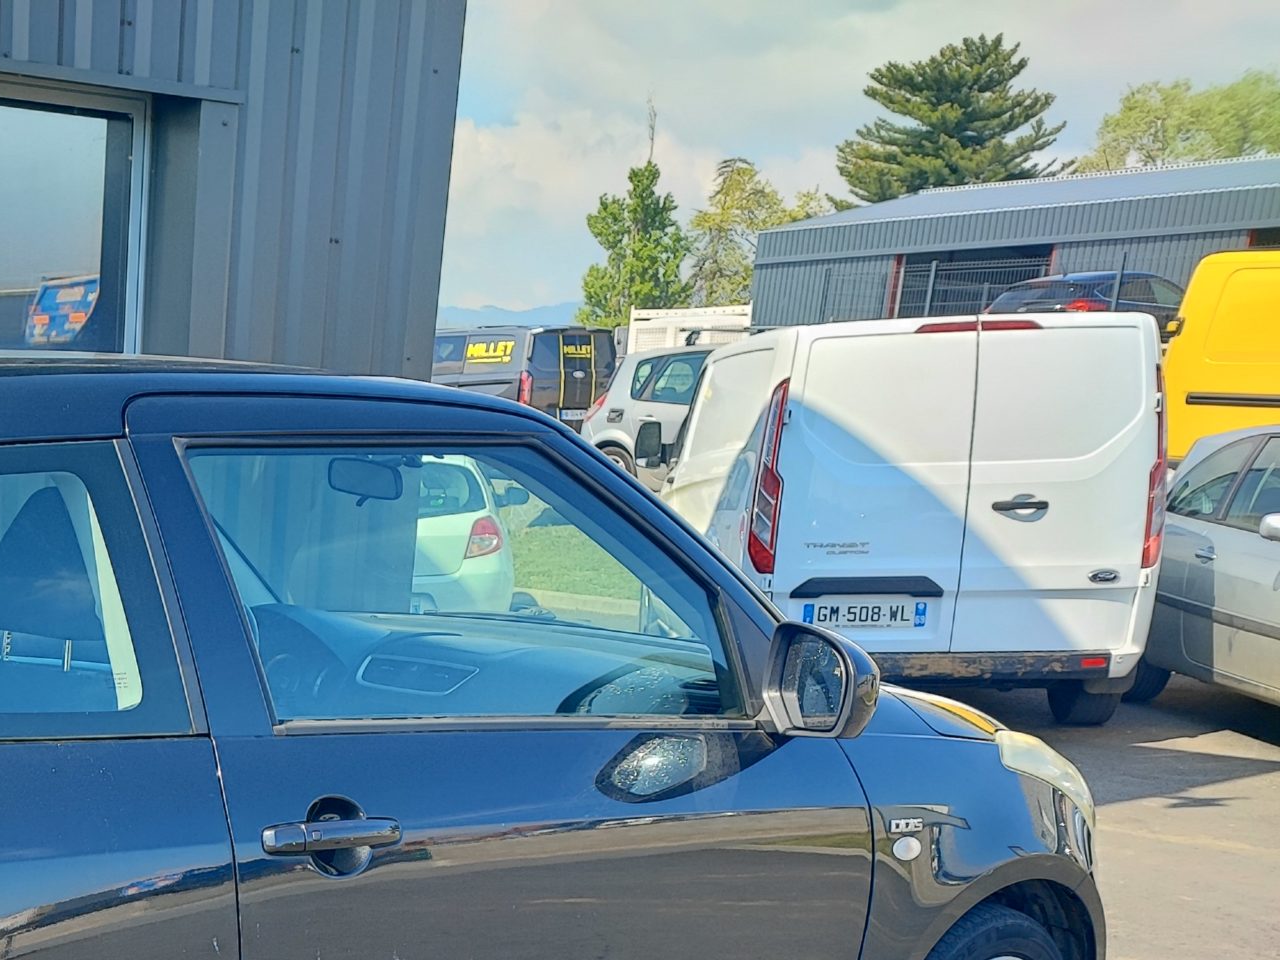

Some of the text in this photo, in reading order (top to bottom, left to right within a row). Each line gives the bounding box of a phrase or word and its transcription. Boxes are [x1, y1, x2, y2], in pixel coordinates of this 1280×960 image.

[466, 340, 515, 359] MILLET
[563, 345, 592, 355] MILLET
[817, 605, 910, 622] GM-508-WL
